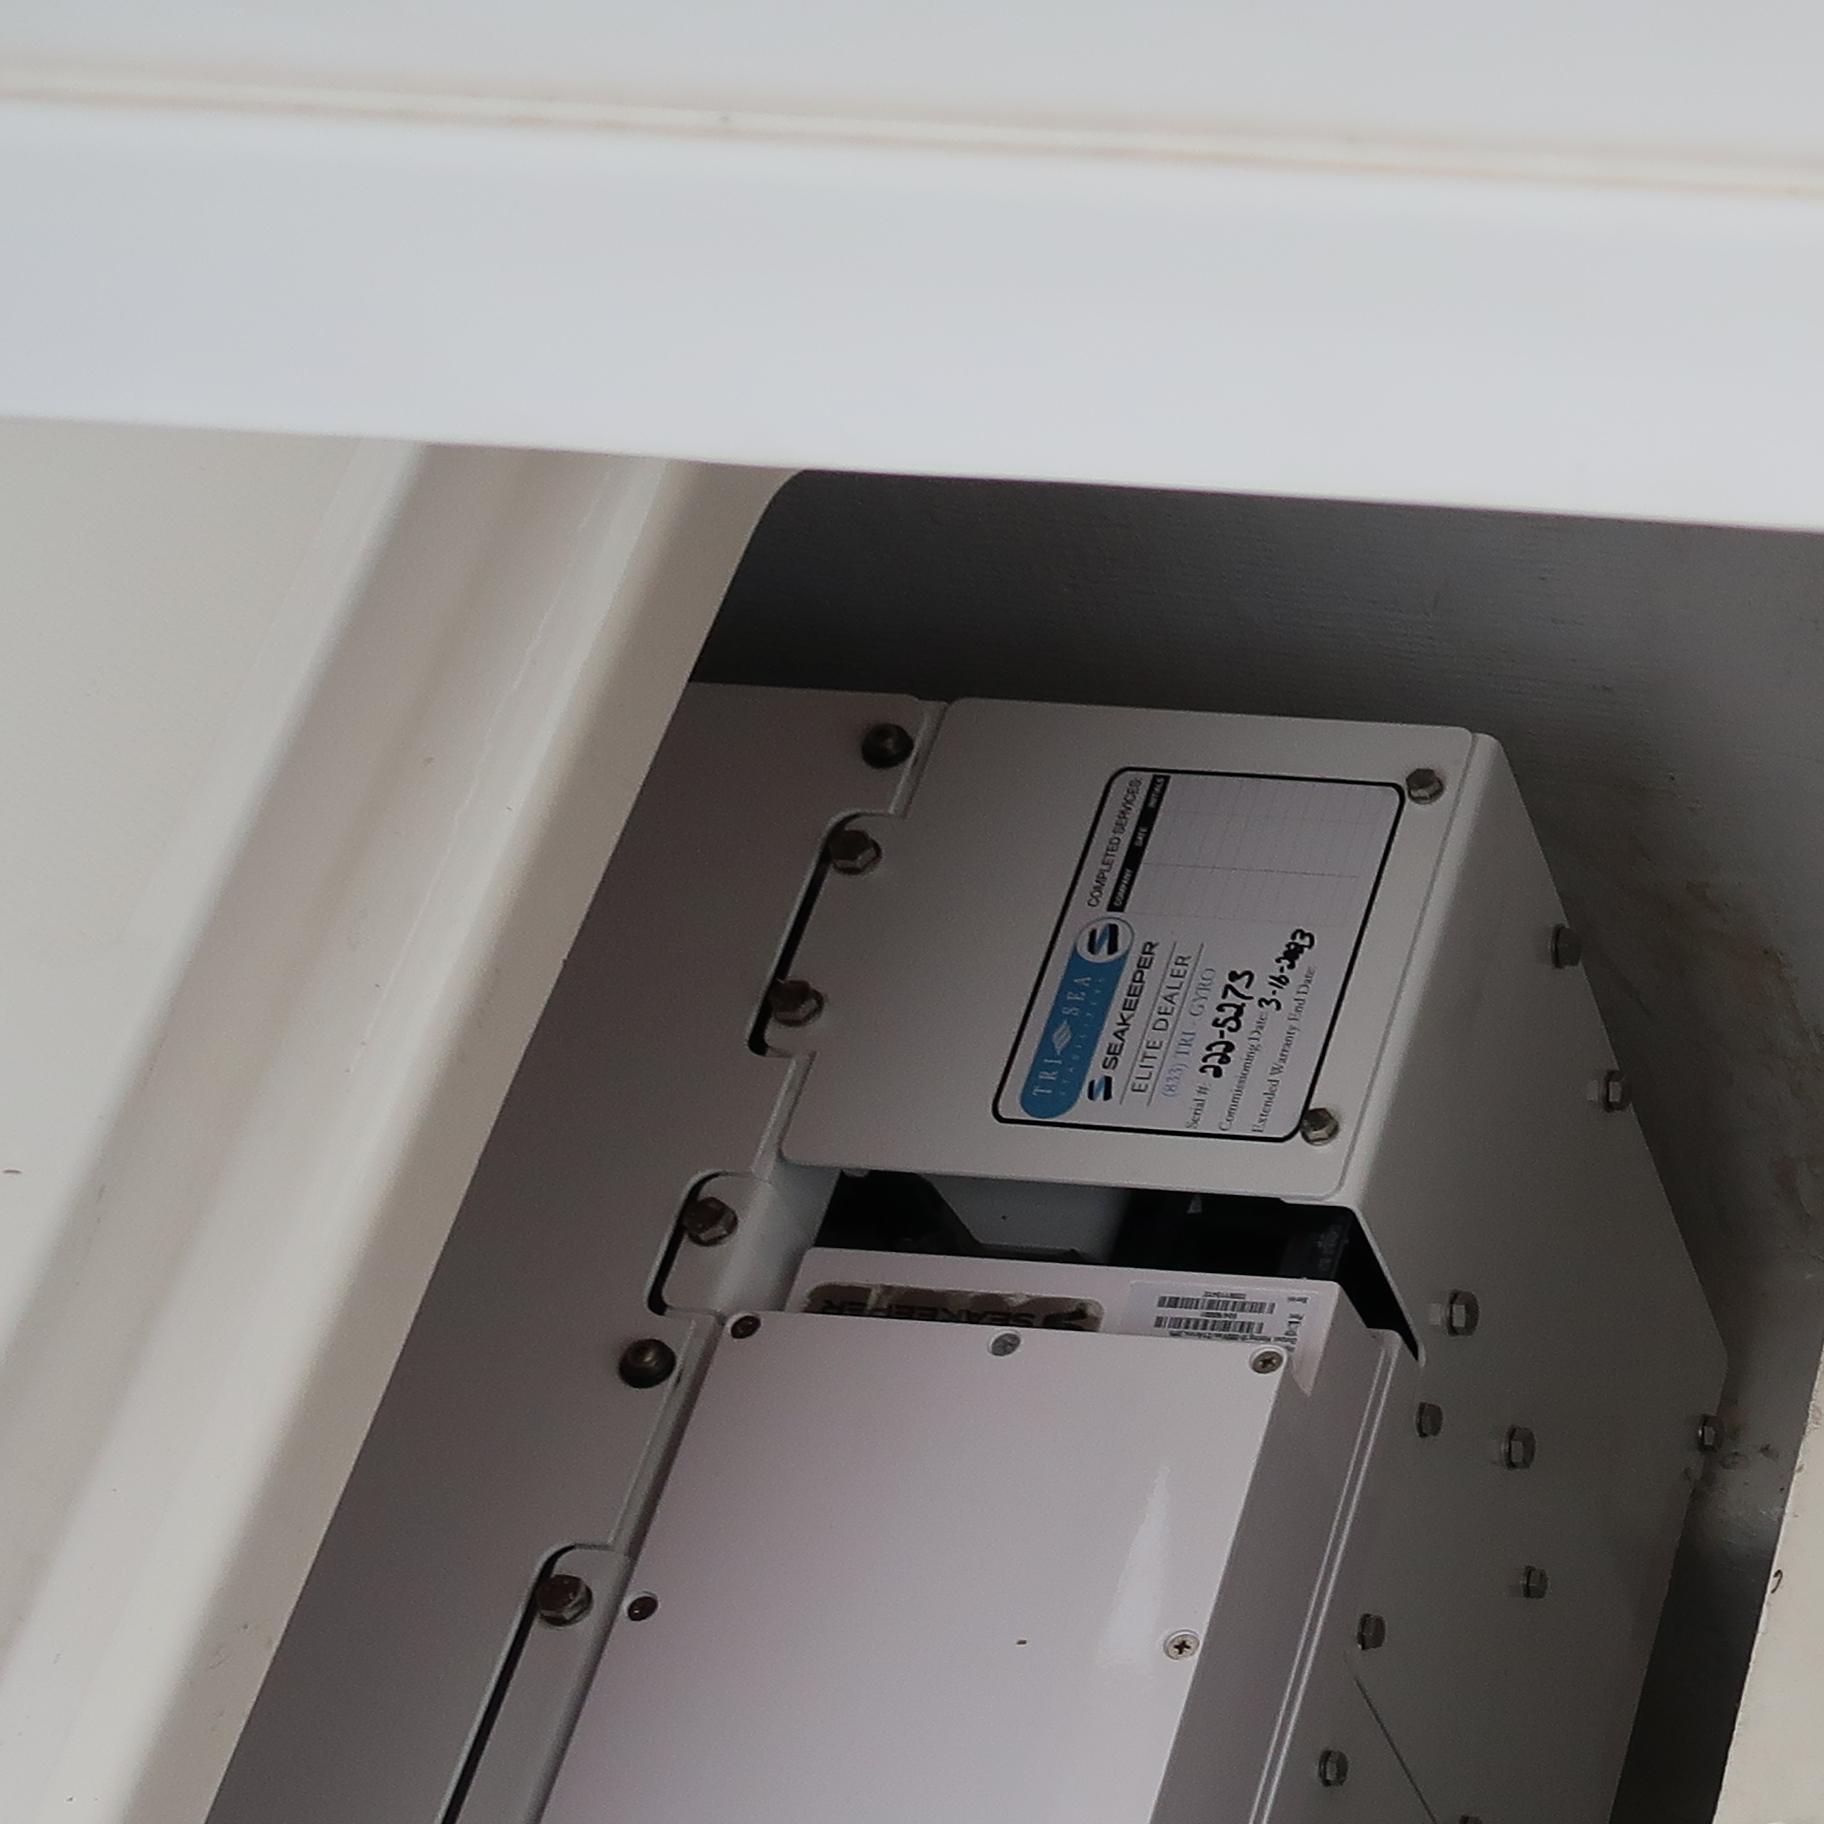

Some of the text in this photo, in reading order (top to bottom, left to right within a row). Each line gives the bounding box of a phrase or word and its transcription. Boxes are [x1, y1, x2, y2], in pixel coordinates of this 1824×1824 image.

[1087, 835, 1122, 907] COMPLETED
[1115, 867, 1134, 905] COMPANY
[1033, 975, 1091, 1096] TRI SEA
[1102, 940, 1158, 1070] SEAKEEPER
[1131, 954, 1192, 1092] ELITE DEALER
[1177, 1030, 1197, 1055] TRI
[1190, 966, 1218, 1017] GYRO
[1219, 1043, 1262, 1131] Commissioning
[1251, 1078, 1280, 1133] Extended
[1271, 1024, 1301, 1075] Warranty
[1289, 998, 1306, 1020] End
[1185, 1097, 1208, 1129] Serial
